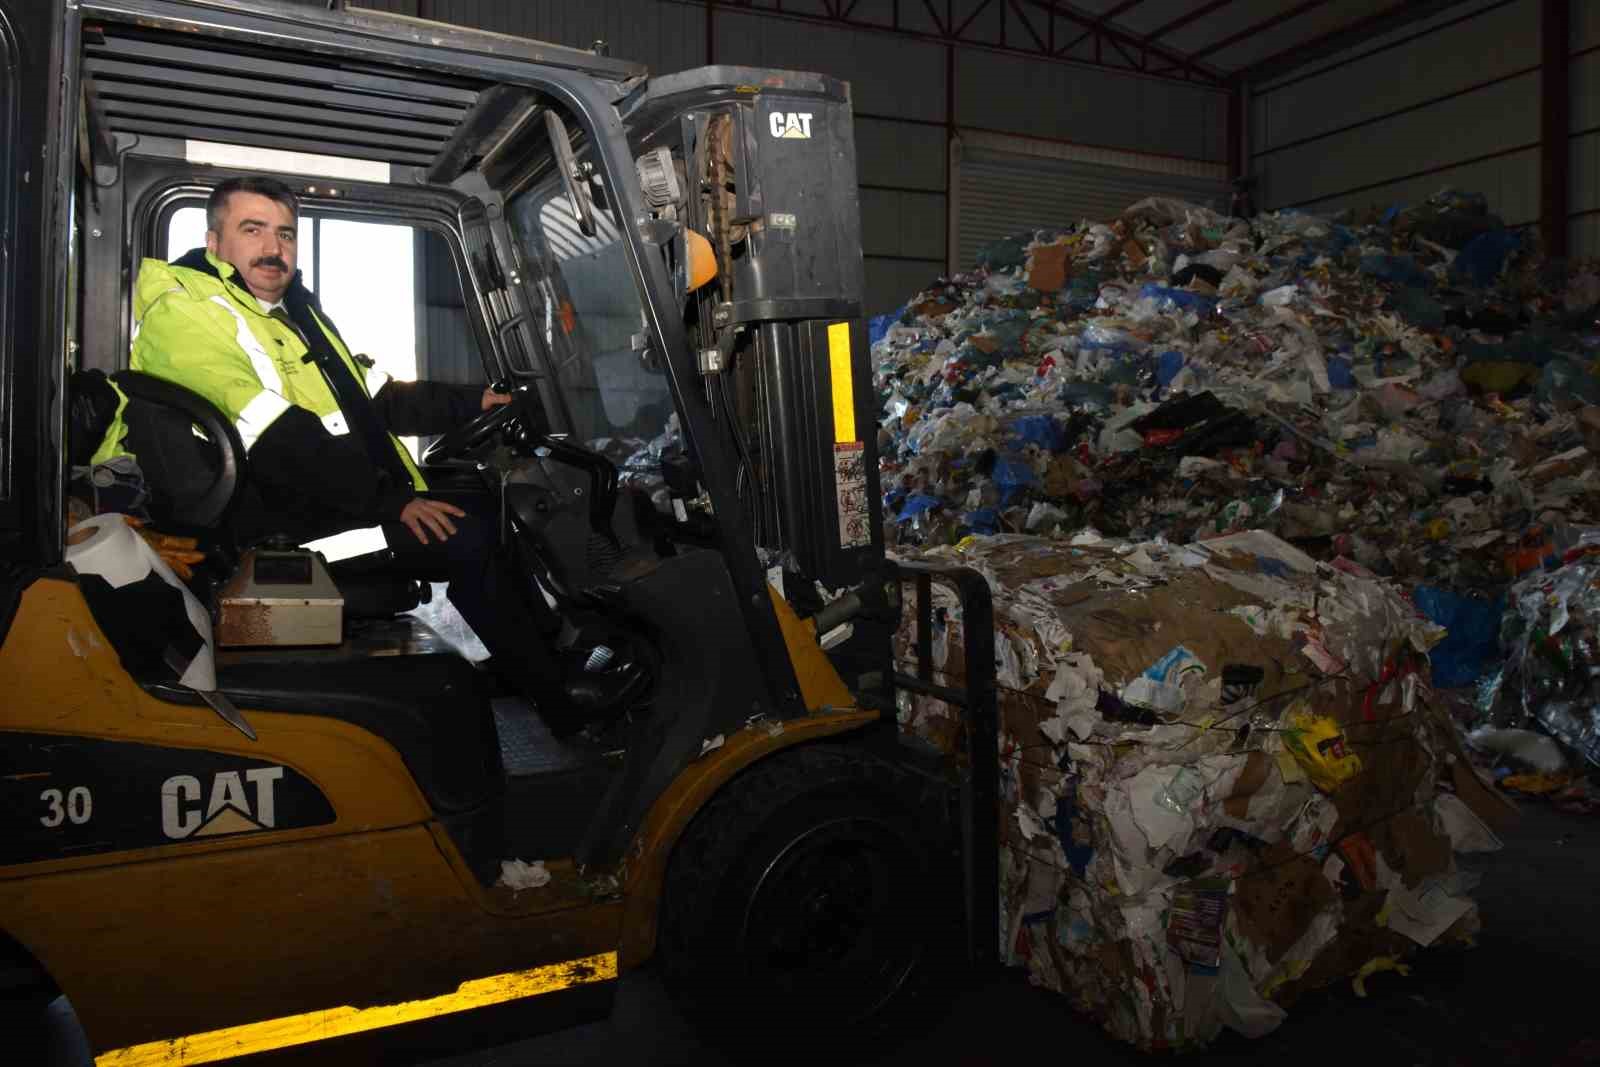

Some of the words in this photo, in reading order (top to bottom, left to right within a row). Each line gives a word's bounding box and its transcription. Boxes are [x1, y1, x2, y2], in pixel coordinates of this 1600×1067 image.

[769, 111, 813, 138] CAT
[39, 786, 93, 828] 30
[161, 766, 284, 839] CAT
